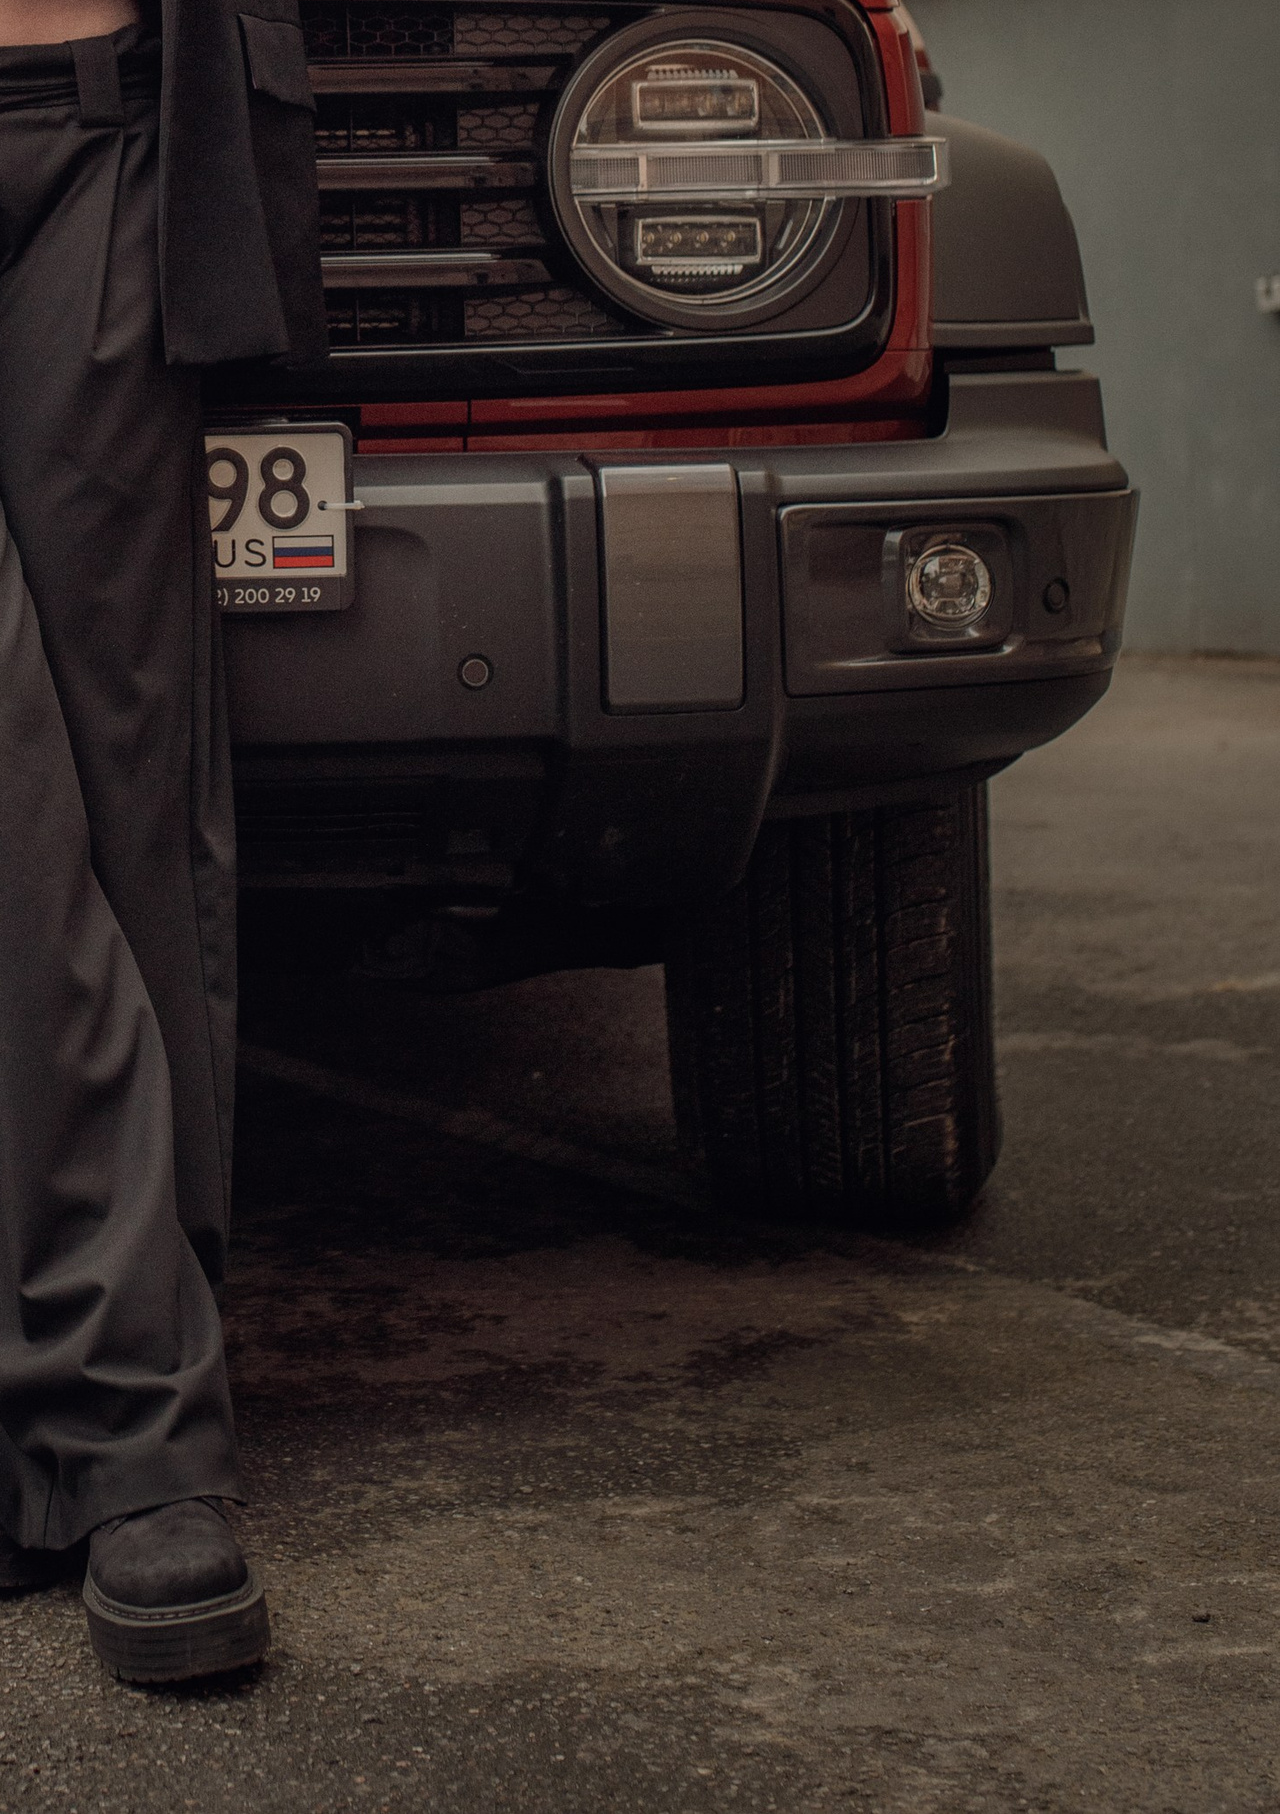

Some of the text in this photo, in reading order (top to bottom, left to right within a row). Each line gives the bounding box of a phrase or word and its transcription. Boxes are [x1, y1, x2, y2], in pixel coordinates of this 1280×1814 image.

[206, 446, 310, 531] 98
[234, 588, 270, 604] 200
[275, 587, 296, 603] 29
[301, 587, 321, 603] 19
